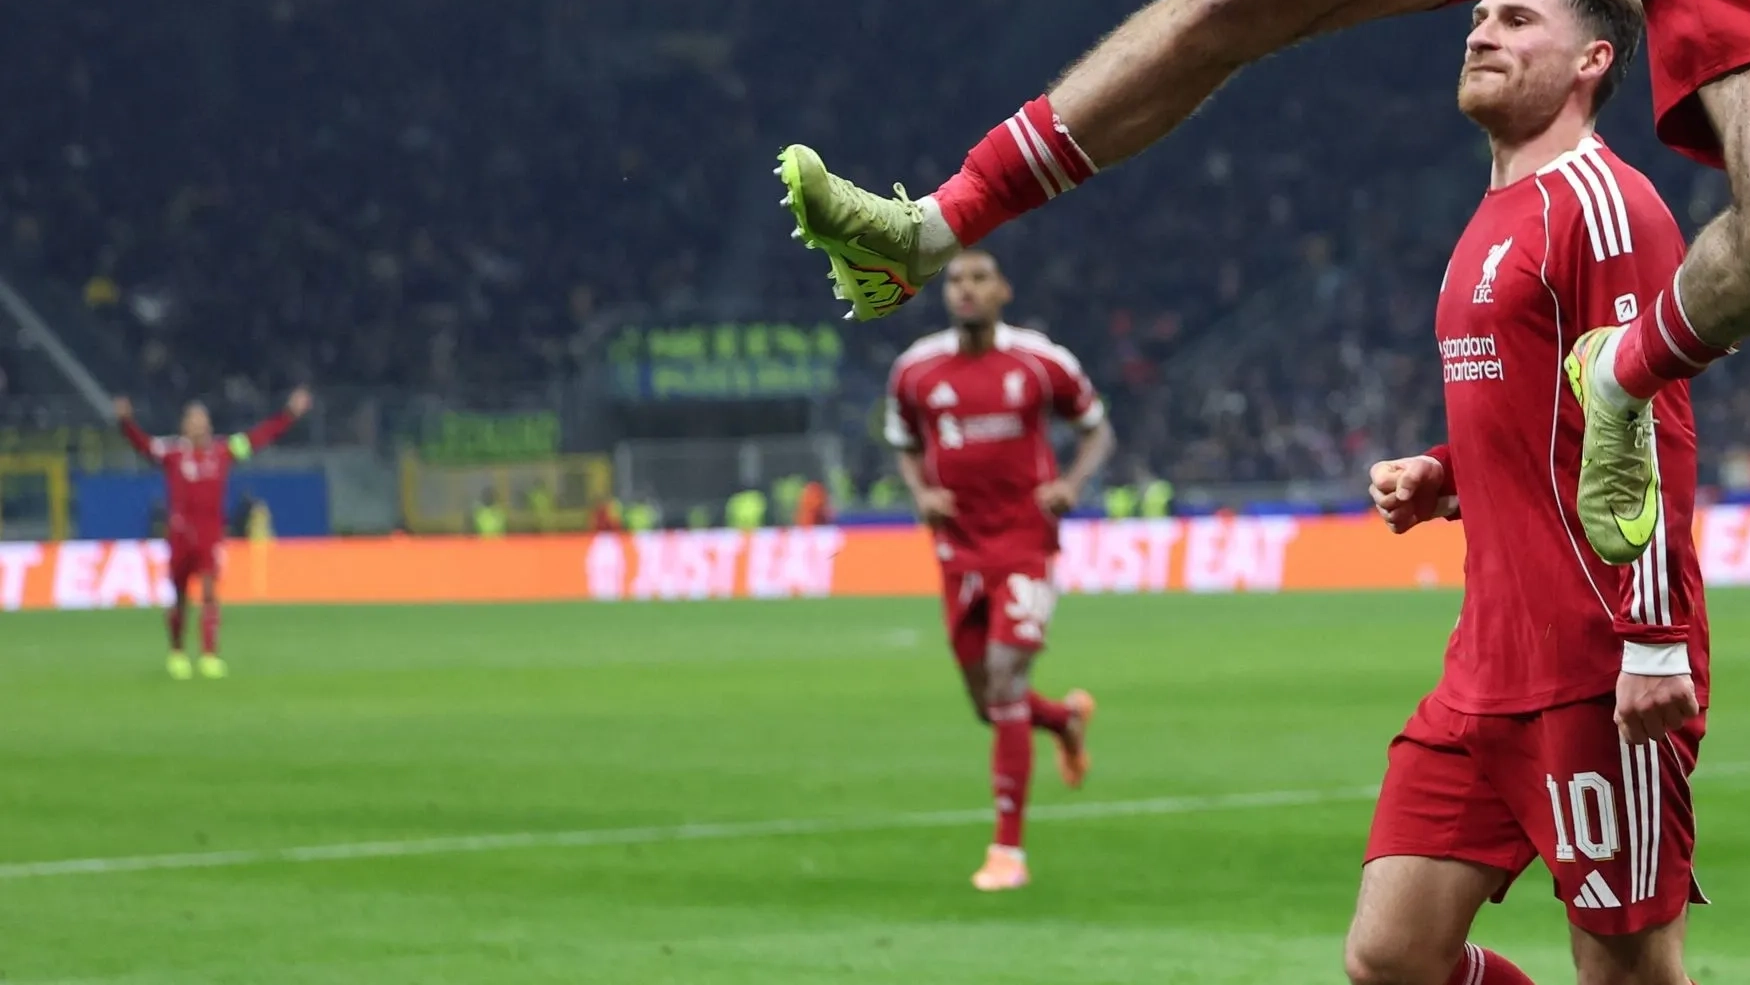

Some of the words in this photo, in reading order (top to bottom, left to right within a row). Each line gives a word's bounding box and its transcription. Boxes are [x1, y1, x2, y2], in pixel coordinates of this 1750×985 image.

[1442, 333, 1497, 360] standard
[1443, 357, 1504, 384] chartered
[747, 523, 846, 599] EAT
[1184, 514, 1299, 593] EAT
[1545, 771, 1621, 863] 10
